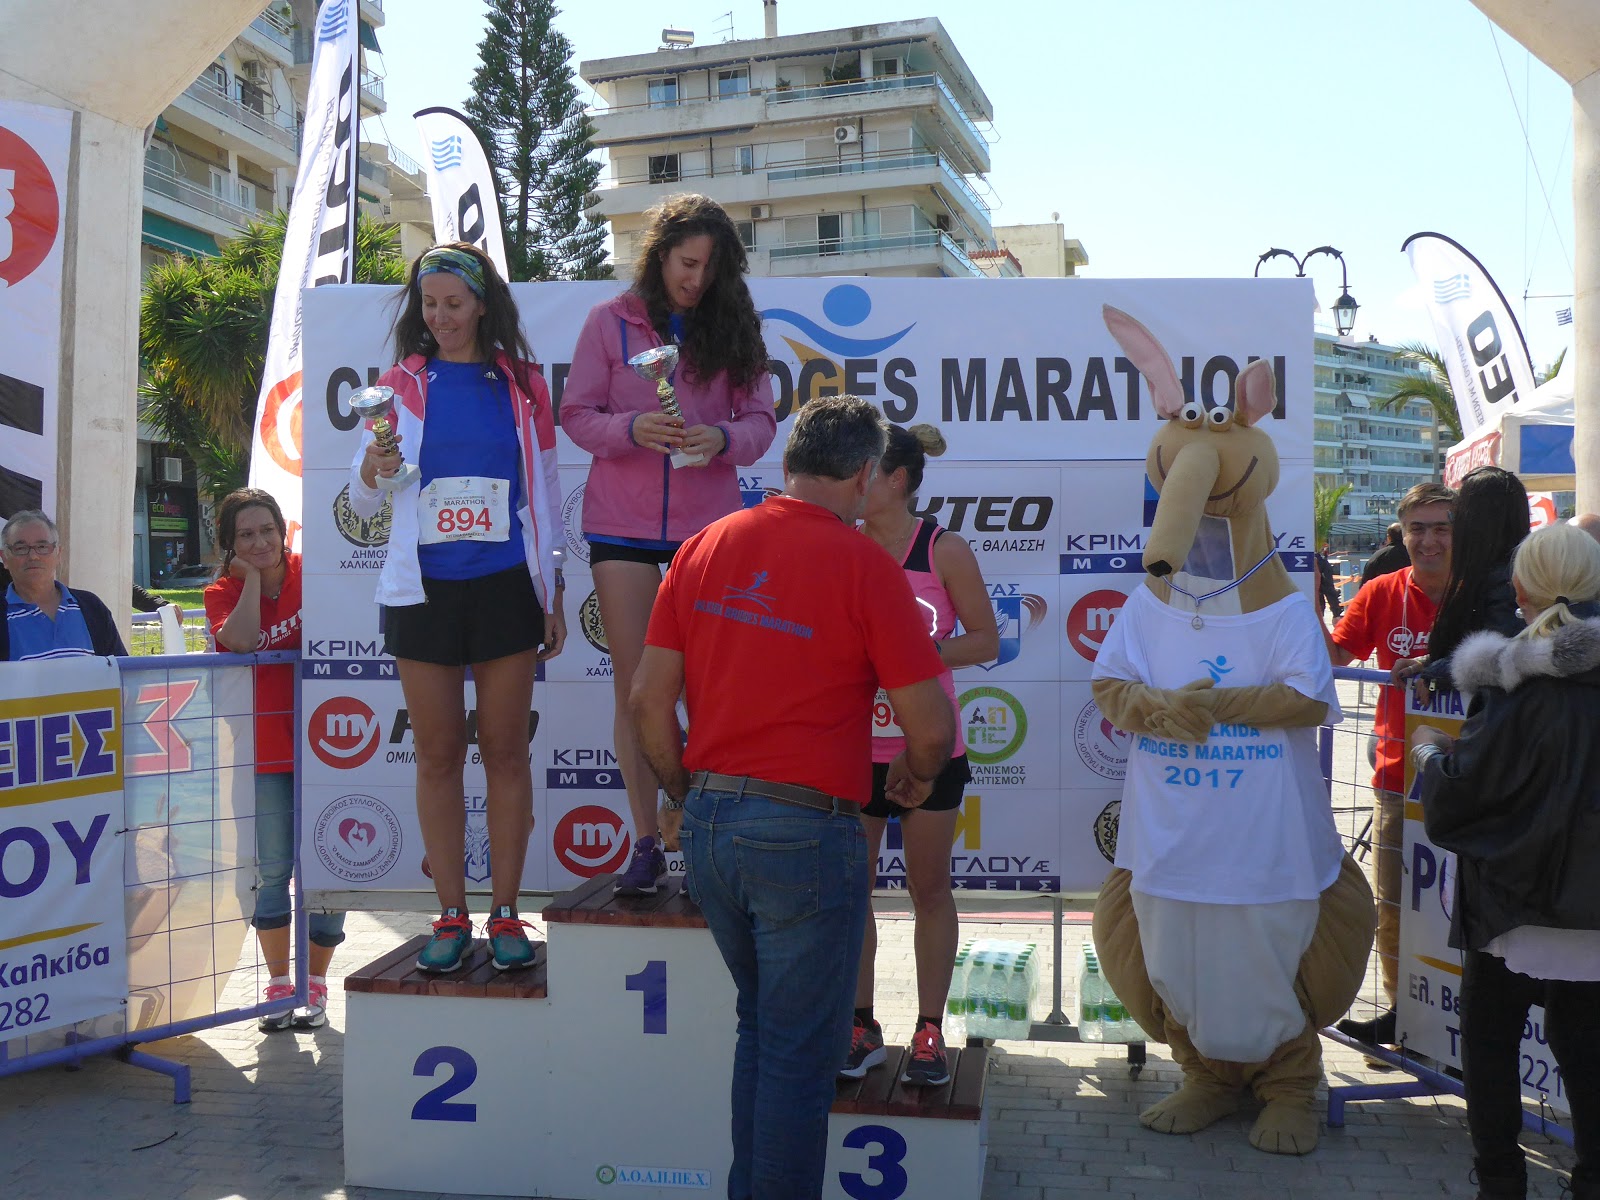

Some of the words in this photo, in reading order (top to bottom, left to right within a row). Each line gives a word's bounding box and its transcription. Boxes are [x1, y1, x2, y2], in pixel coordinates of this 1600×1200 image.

[443, 499, 486, 507] MARATHON
[436, 507, 493, 533] 894
[983, 539, 1045, 552] ΘΑΛΑΣΣΗ
[340, 560, 386, 569] ΧΑΛΚΙΔΕ
[760, 614, 815, 640] MARATHON
[1209, 722, 1261, 738] LKIDA
[1137, 735, 1189, 759] RIDGES
[969, 776, 1027, 785] ΛΗΤΙΣΜΟΥ
[970, 765, 1026, 775] ΓΑΝΙΣΜΟΣ
[1163, 765, 1245, 789] 2017
[624, 959, 668, 1035] 1
[410, 1044, 478, 1123] 2
[838, 1123, 909, 1200] 3
